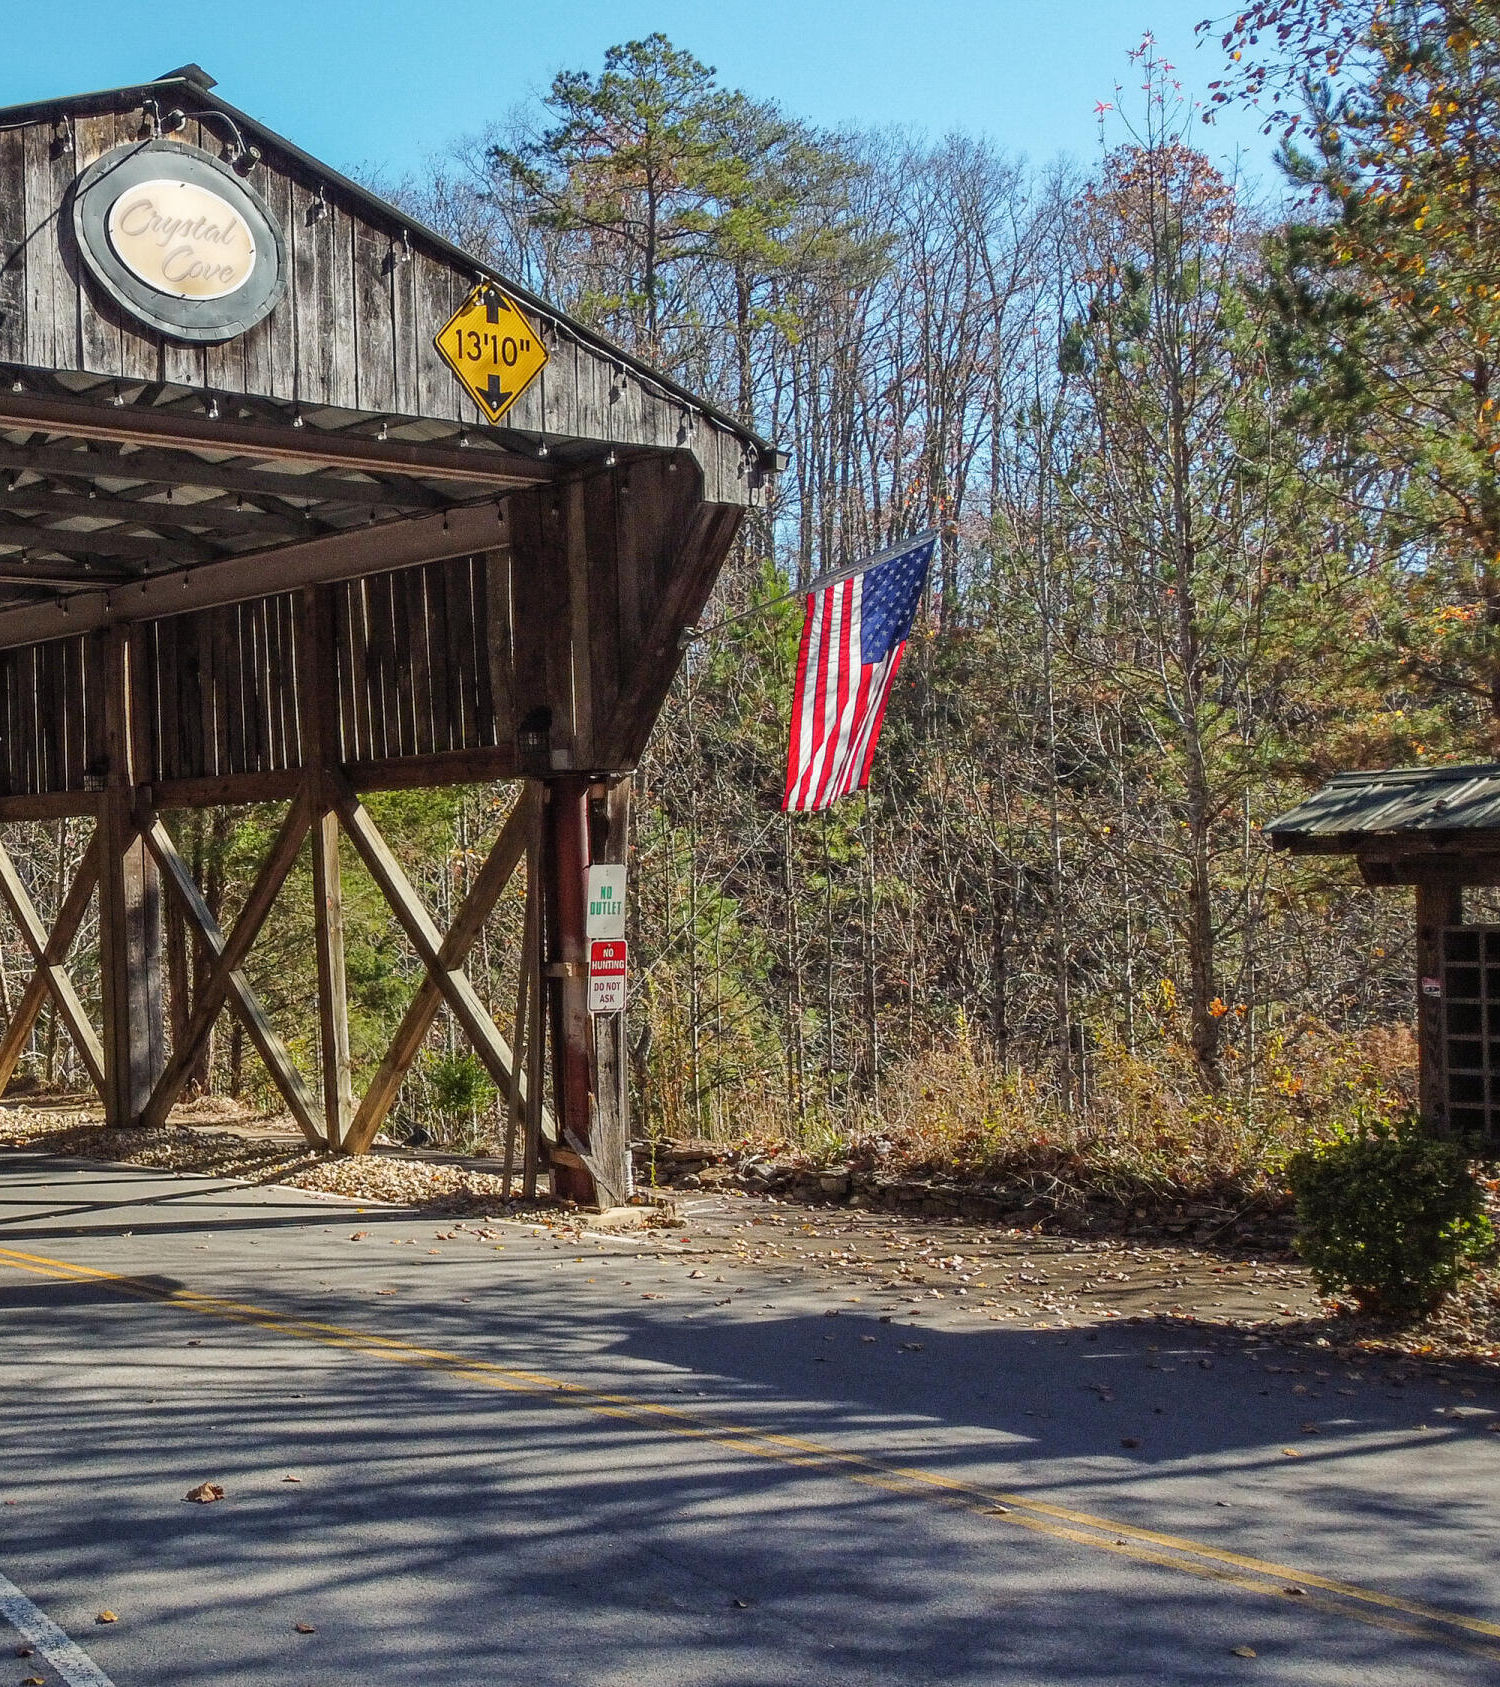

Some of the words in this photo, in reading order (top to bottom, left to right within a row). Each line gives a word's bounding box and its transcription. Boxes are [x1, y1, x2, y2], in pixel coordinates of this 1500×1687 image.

[120, 199, 238, 247] Crystal
[162, 245, 236, 283] Cove
[456, 329, 530, 367] 13'10"
[601, 886, 612, 899] NO
[590, 901, 622, 915] OUTLET
[603, 948, 614, 958] NO
[592, 960, 624, 970] HUNTING
[594, 983, 604, 991] DO
[606, 982, 621, 991] NOT
[600, 994, 614, 1003] ASK
